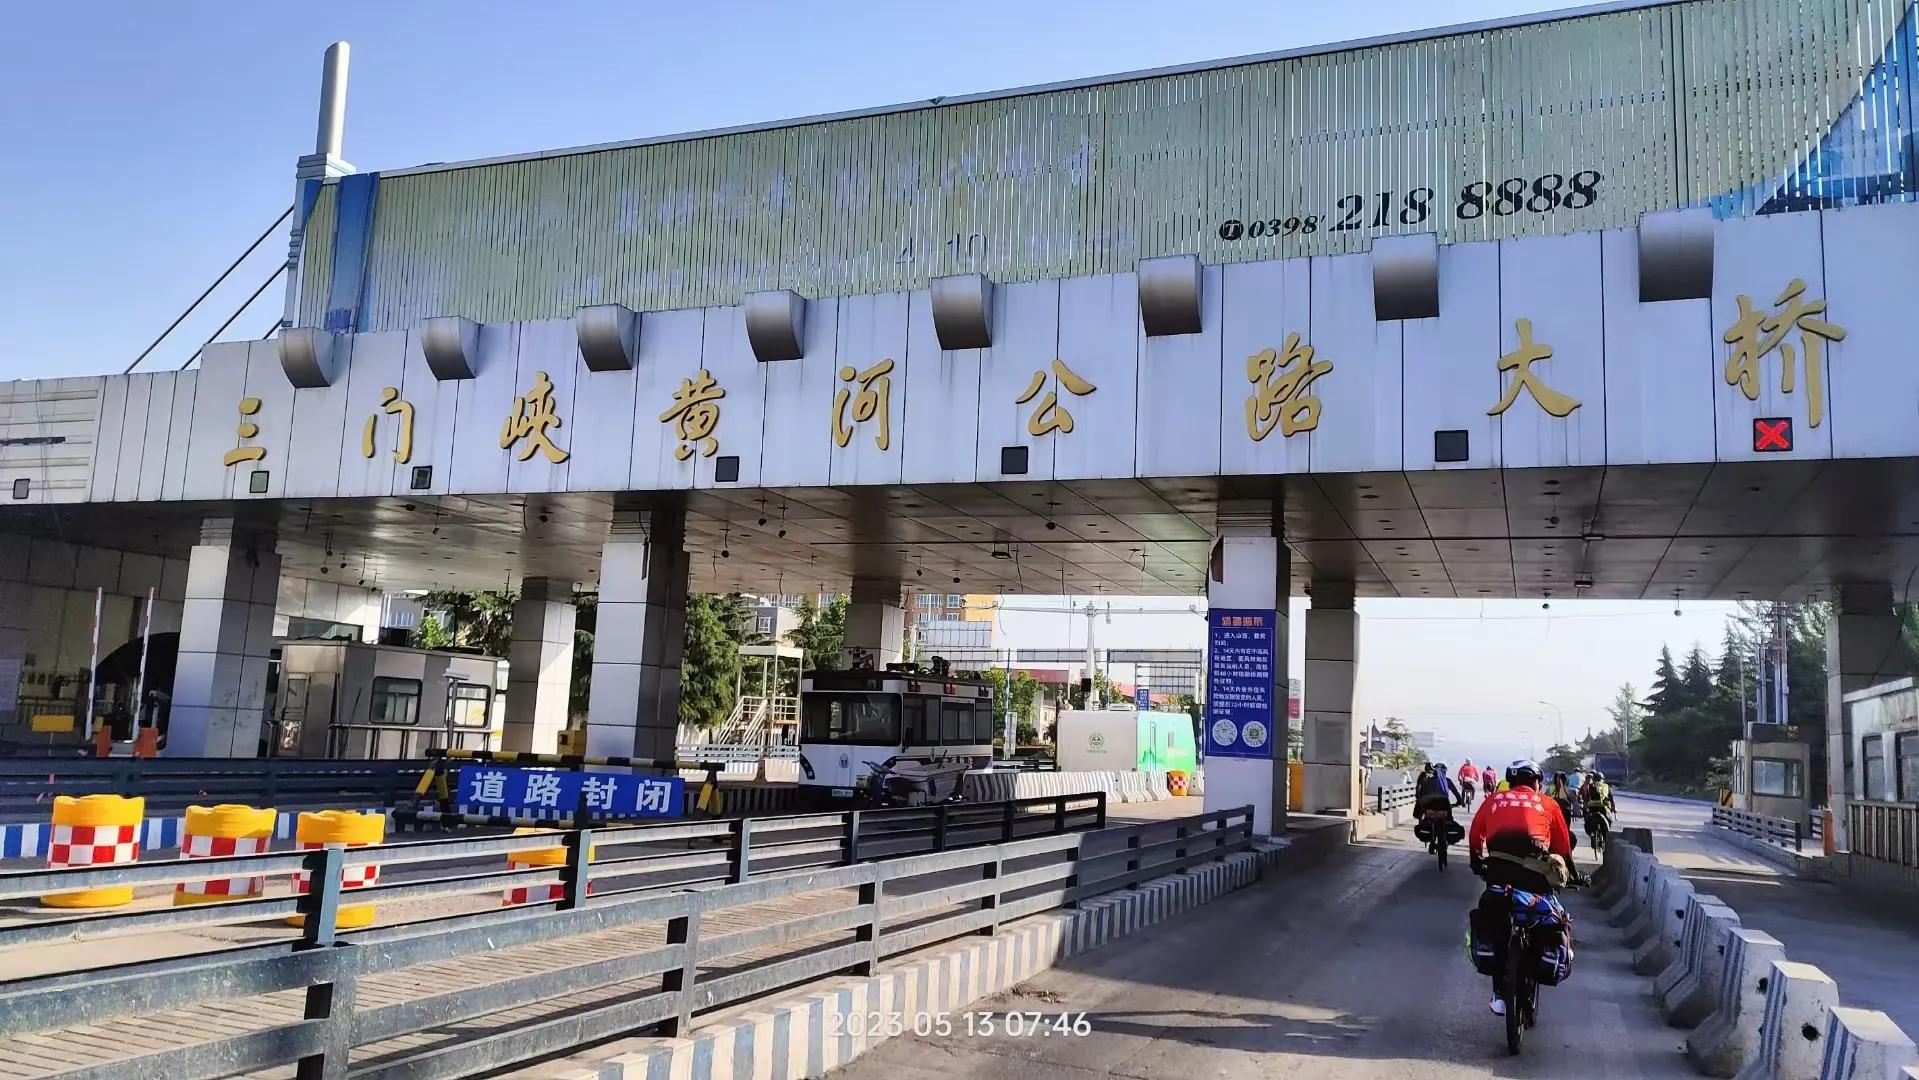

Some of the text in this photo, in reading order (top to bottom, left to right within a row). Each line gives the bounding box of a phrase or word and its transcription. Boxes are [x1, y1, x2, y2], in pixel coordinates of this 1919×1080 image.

[1329, 187, 1434, 231] 218
[1456, 170, 1602, 219] 8888
[224, 279, 1846, 466] 三门峡黄河公路大桥
[470, 771, 673, 813] 道路封闭
